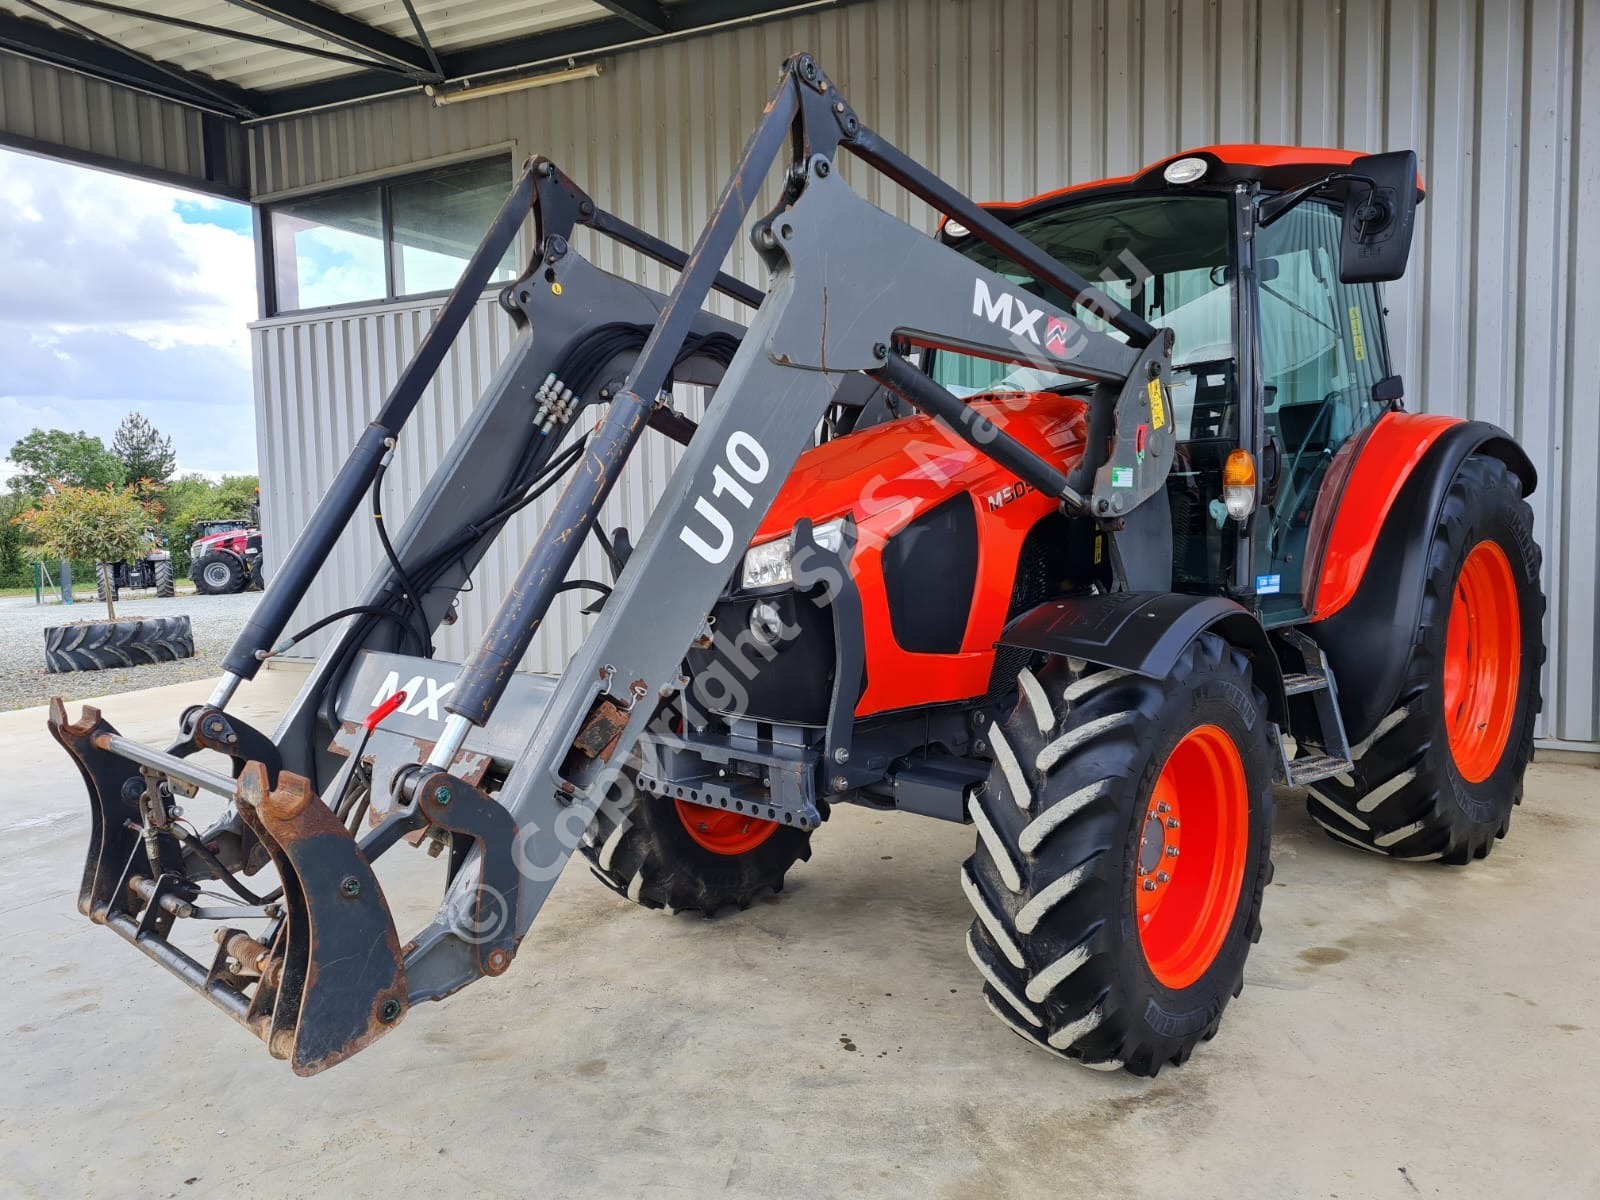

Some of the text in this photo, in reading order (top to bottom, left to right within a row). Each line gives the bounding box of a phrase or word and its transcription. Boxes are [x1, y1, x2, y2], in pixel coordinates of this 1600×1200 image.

[973, 278, 1045, 345] MX
[680, 431, 770, 564] U10
[371, 671, 456, 721] MX
